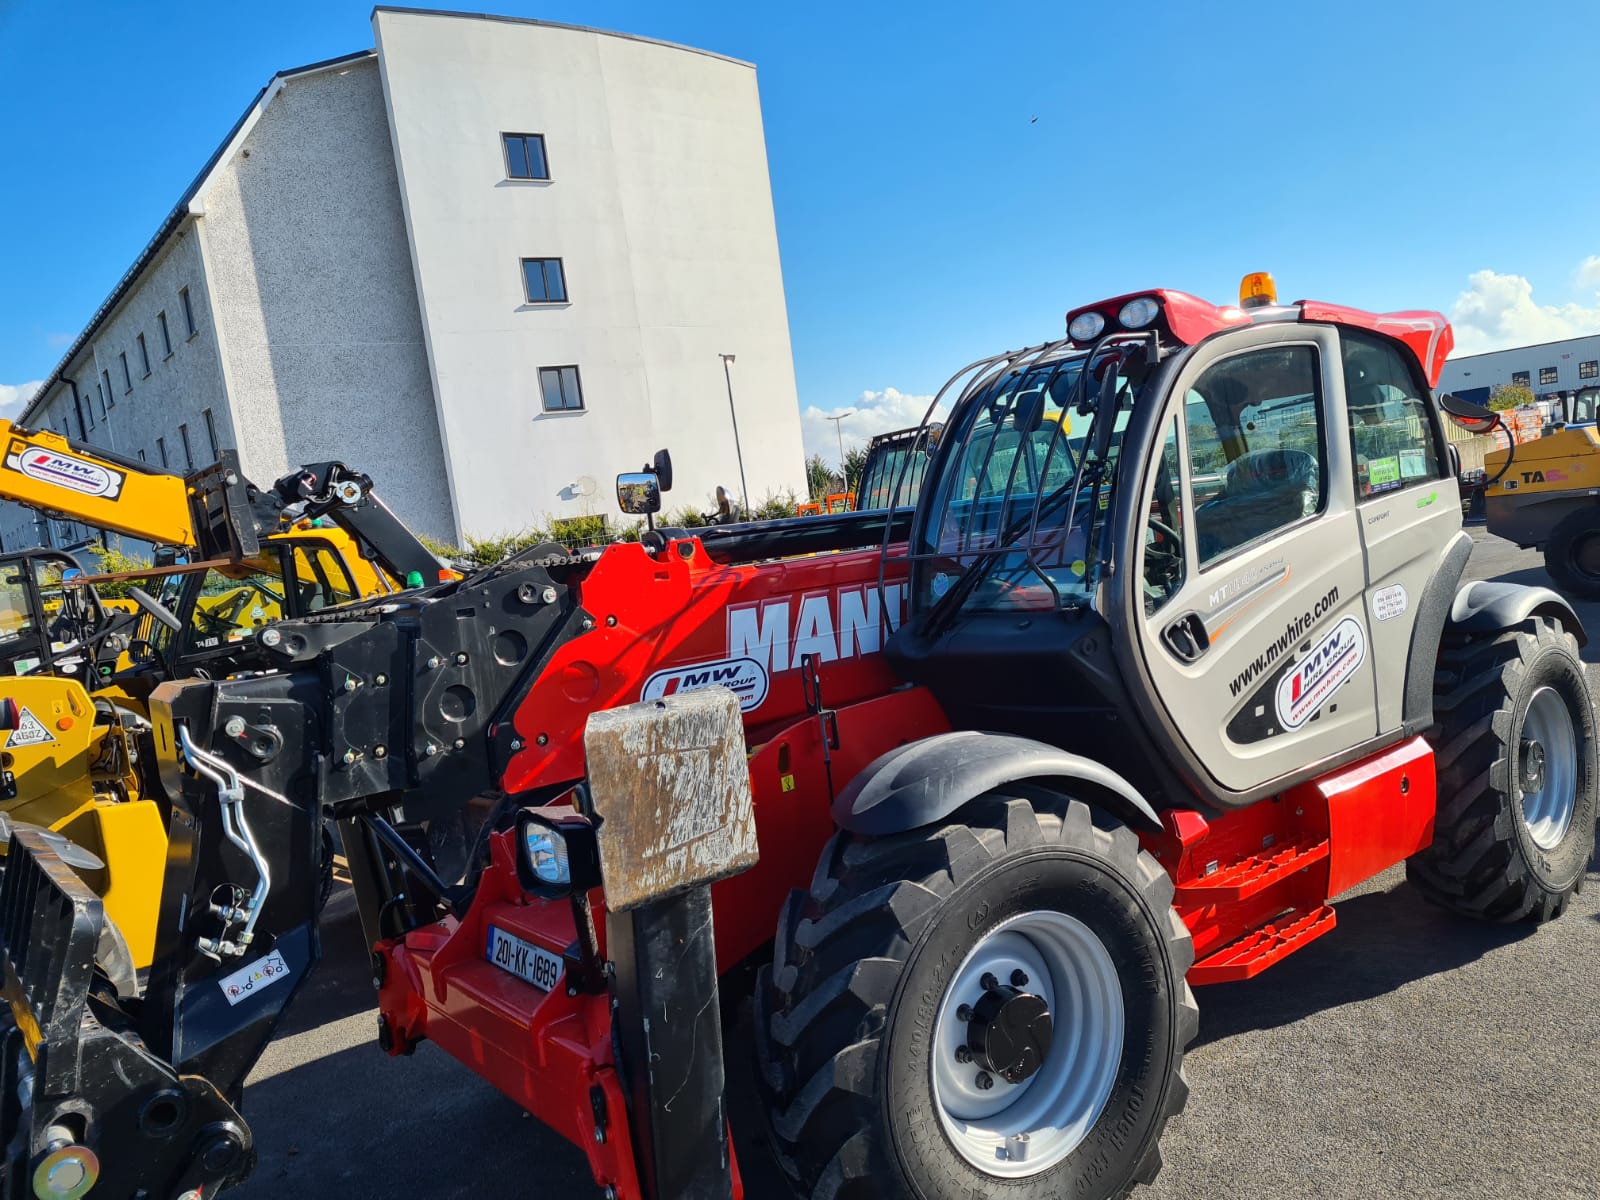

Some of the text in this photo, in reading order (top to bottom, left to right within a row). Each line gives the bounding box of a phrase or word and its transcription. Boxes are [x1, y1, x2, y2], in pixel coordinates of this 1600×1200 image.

[51, 459, 95, 475] MW
[1229, 586, 1339, 697] www.mwhire.com
[1303, 634, 1355, 692] HIRE GROUP
[1304, 631, 1342, 679] MW
[682, 665, 742, 688] MW
[1292, 652, 1358, 722] www.mwhire.com
[495, 936, 558, 988] 201-KK-1689
